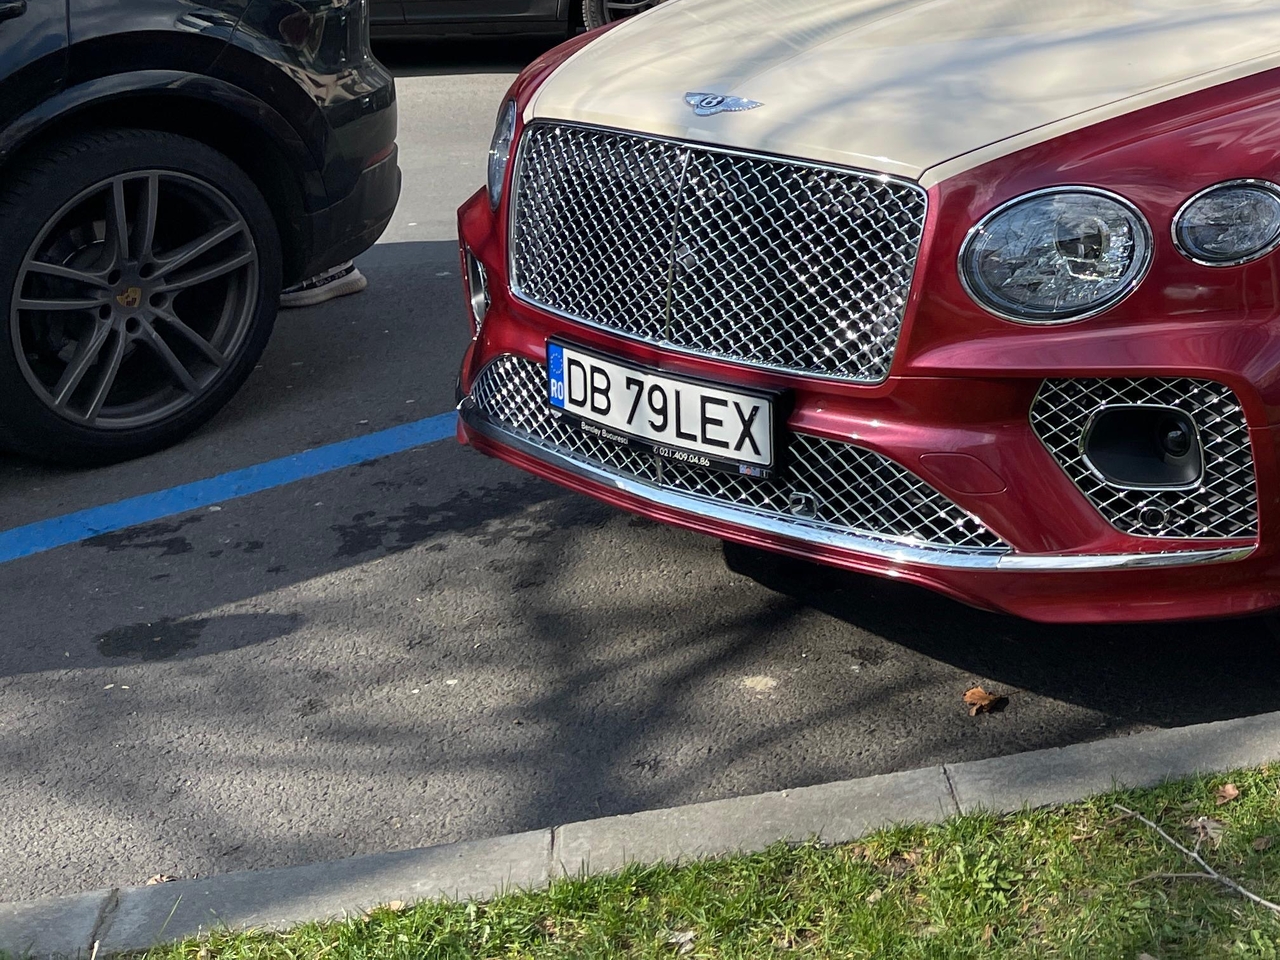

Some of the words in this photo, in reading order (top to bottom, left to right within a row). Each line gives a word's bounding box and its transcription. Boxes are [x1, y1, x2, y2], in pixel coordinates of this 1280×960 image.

[550, 379, 564, 400] RO
[567, 357, 612, 416] DB
[580, 421, 601, 438] Bentley
